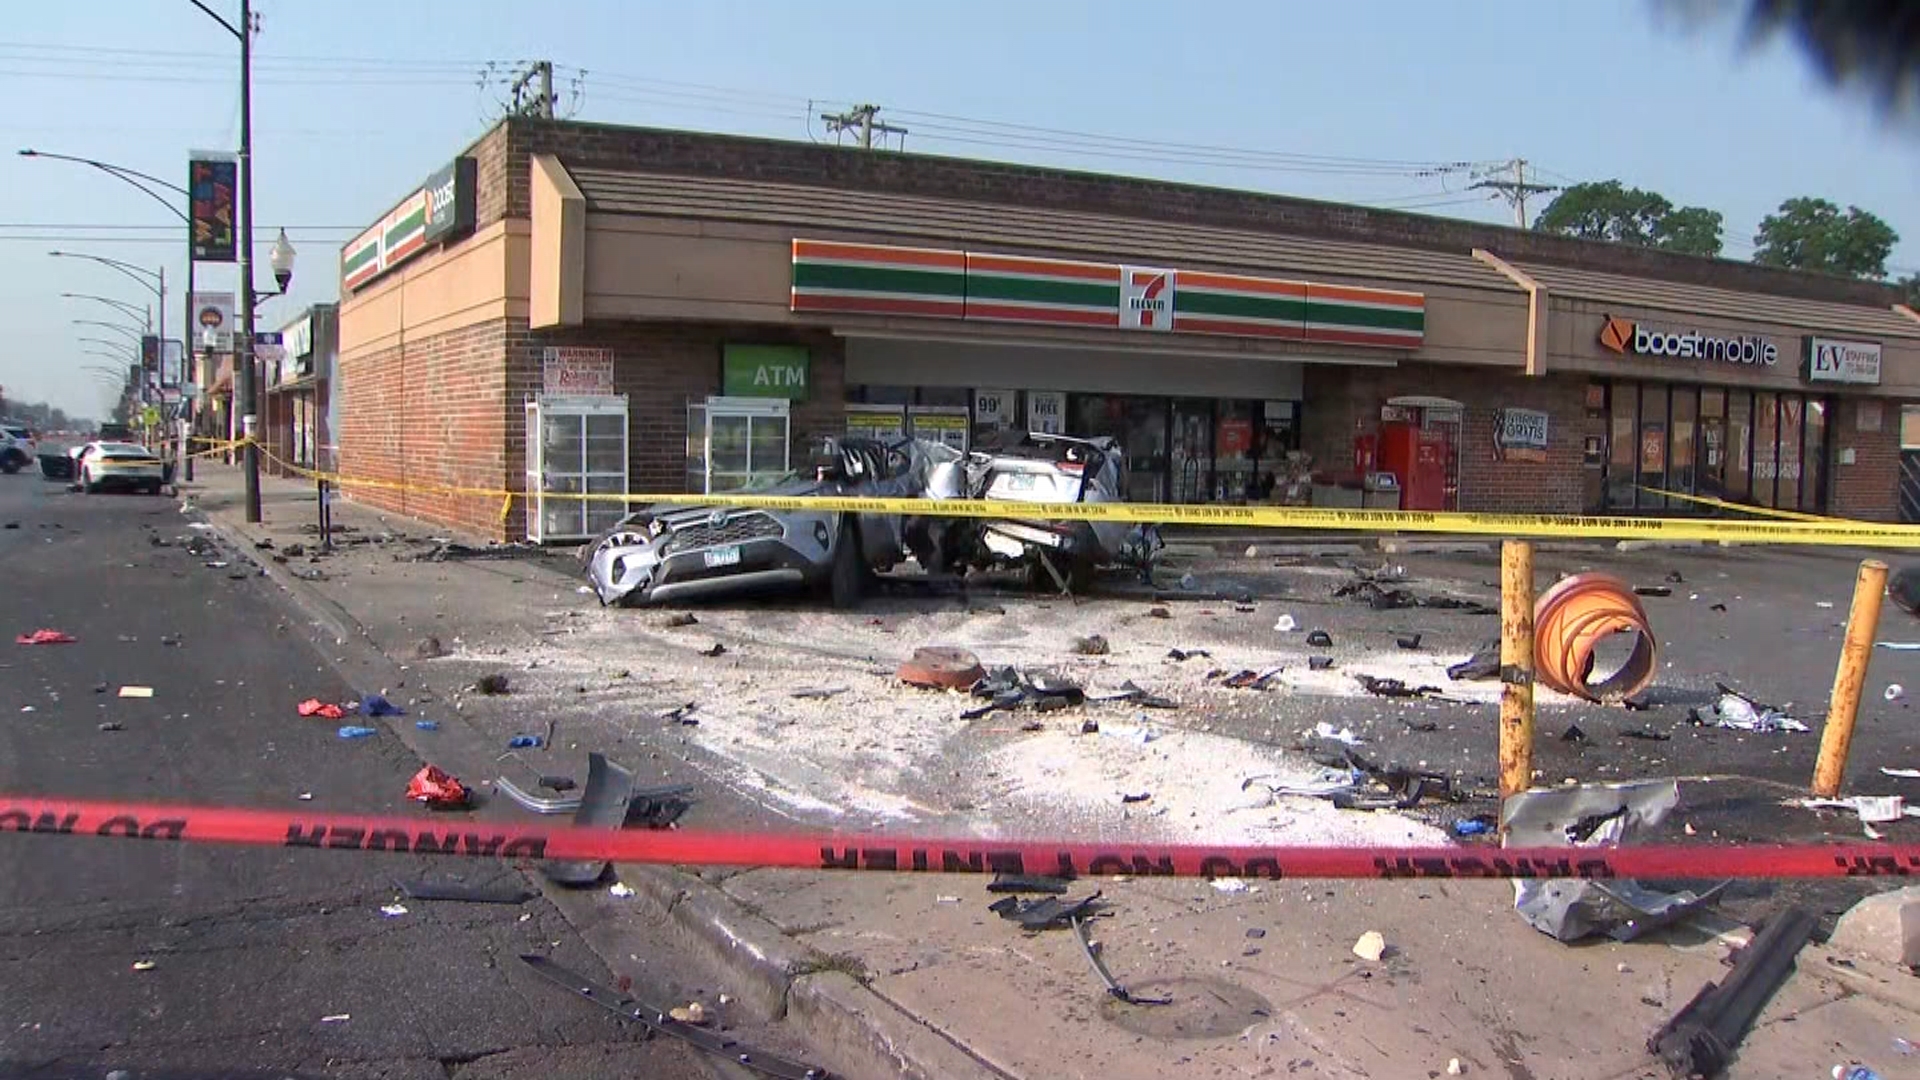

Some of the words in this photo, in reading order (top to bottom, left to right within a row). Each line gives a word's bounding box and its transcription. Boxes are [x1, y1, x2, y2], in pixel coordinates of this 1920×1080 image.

[1131, 273, 1165, 325] 7
[753, 365, 805, 386] ATM
[1506, 423, 1544, 439] GRATIS
